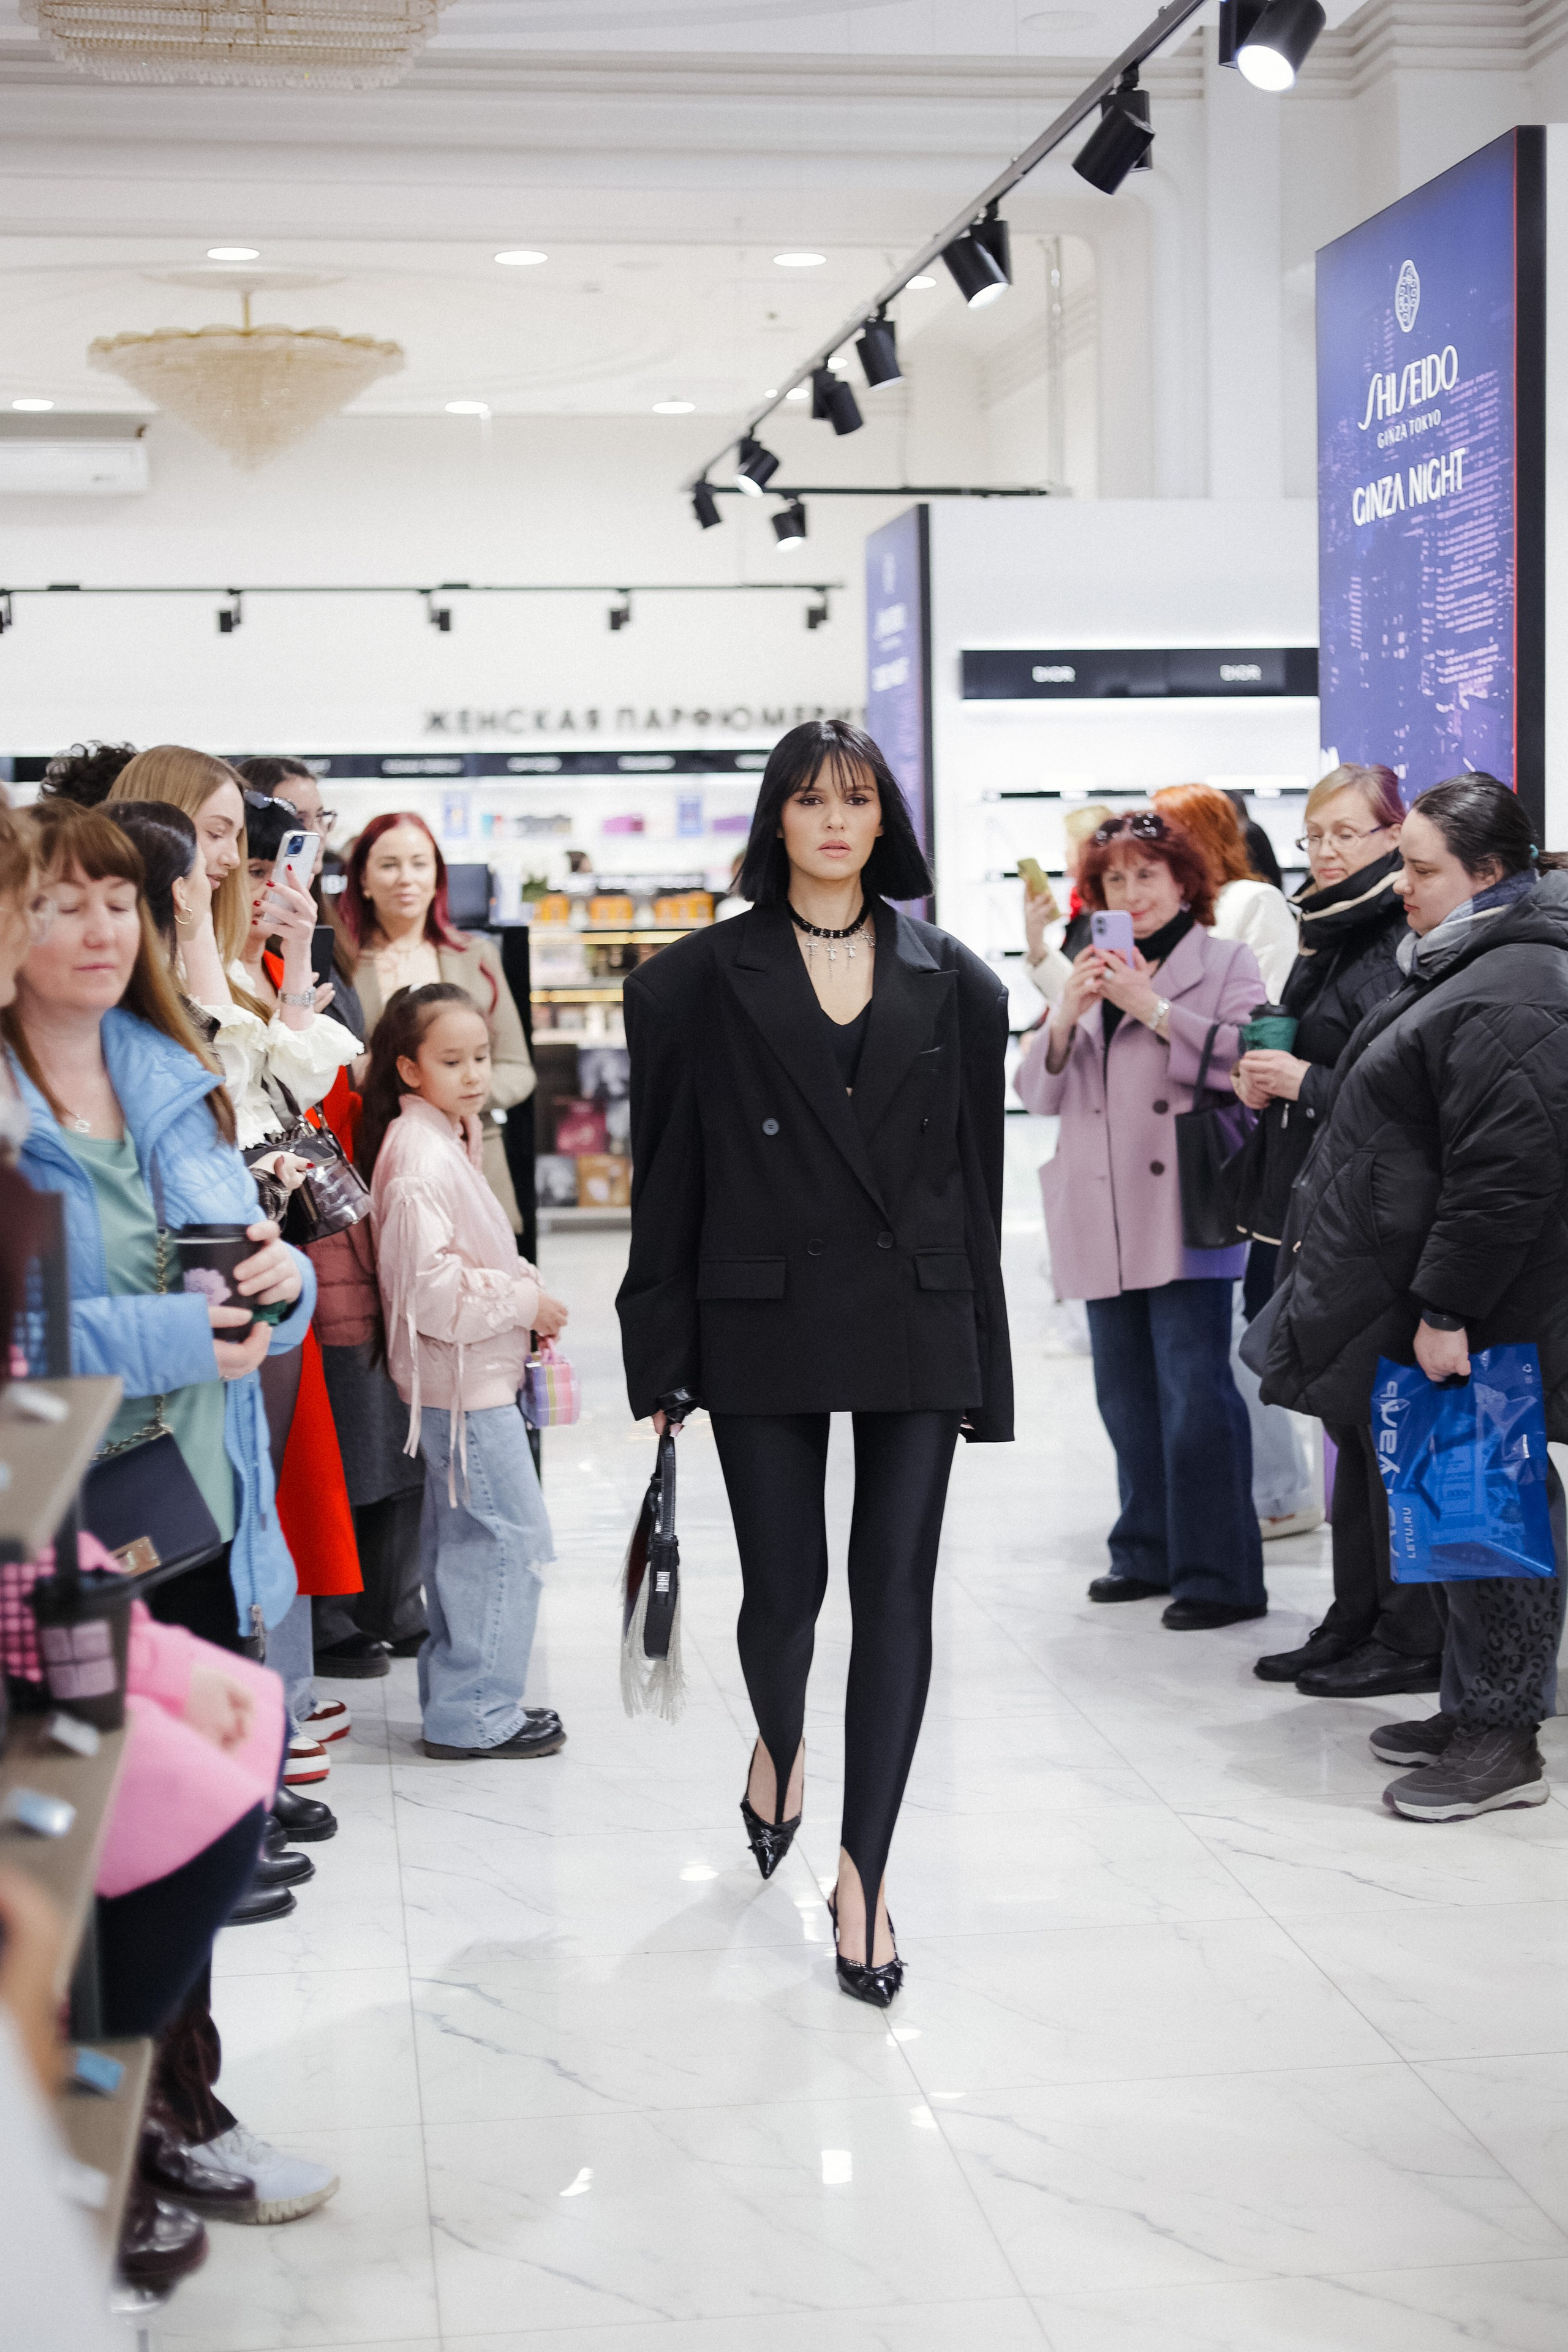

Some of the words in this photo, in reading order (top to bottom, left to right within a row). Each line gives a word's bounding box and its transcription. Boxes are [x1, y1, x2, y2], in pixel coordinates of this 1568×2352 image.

[1357, 345, 1459, 430] SHISEIDO
[1377, 425, 1407, 449] GINZA
[1409, 409, 1442, 435] TOKYO
[1352, 473, 1406, 527] GINZA
[1409, 447, 1466, 508] NIGHT
[424, 707, 602, 734] ЖЕНСКАЯ
[1403, 1506, 1416, 1559] LETU.RU
